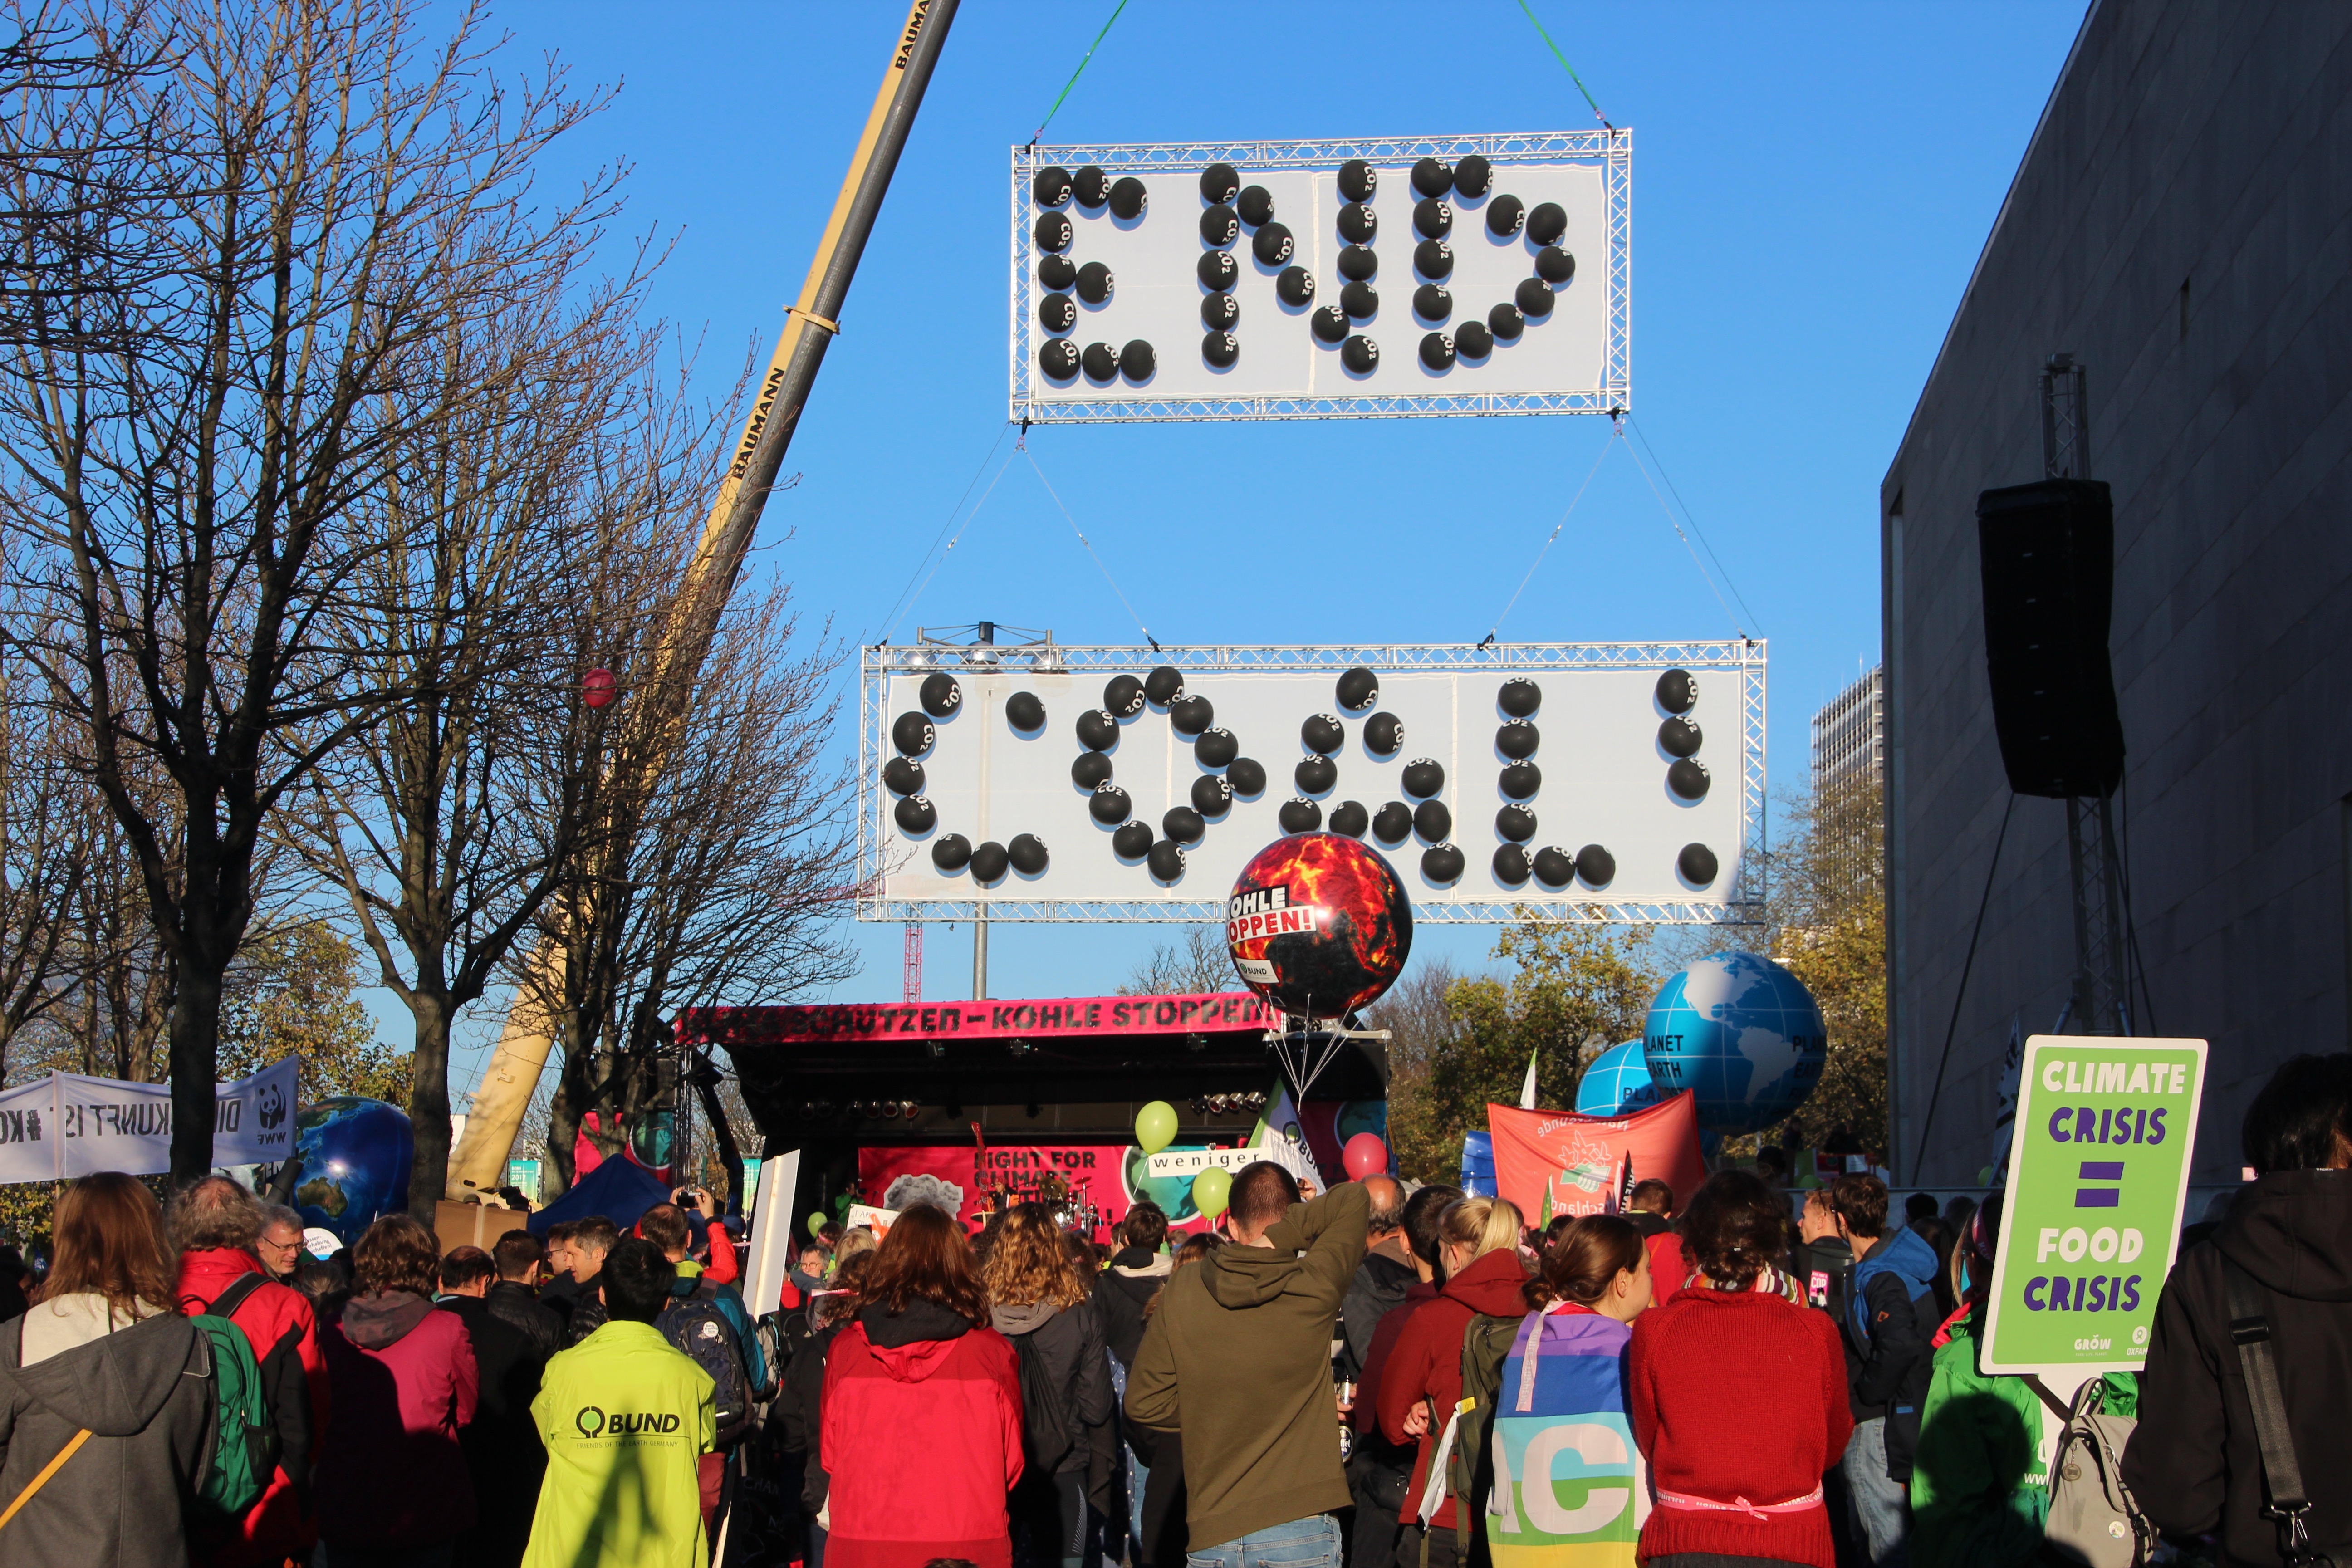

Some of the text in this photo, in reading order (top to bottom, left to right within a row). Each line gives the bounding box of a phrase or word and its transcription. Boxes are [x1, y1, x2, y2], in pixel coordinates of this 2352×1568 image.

[731, 368, 785, 480] BAUMANN
[1228, 887, 1285, 918] OHLE
[1228, 909, 1311, 942] OPPEN!
[992, 1003, 1102, 1030] KOHLE
[2042, 1060, 2186, 1094] CLIMATE
[2048, 1107, 2168, 1145] CRISIS
[1051, 1151, 1096, 1168] FOR
[1154, 1152, 1261, 1168] weniger
[2036, 1227, 2144, 1263] FOOD
[1811, 1277, 1827, 1289] COP
[2023, 1275, 2142, 1312] CRISIS
[2074, 1338, 2111, 1350] GROW
[608, 1413, 680, 1434] BUND
